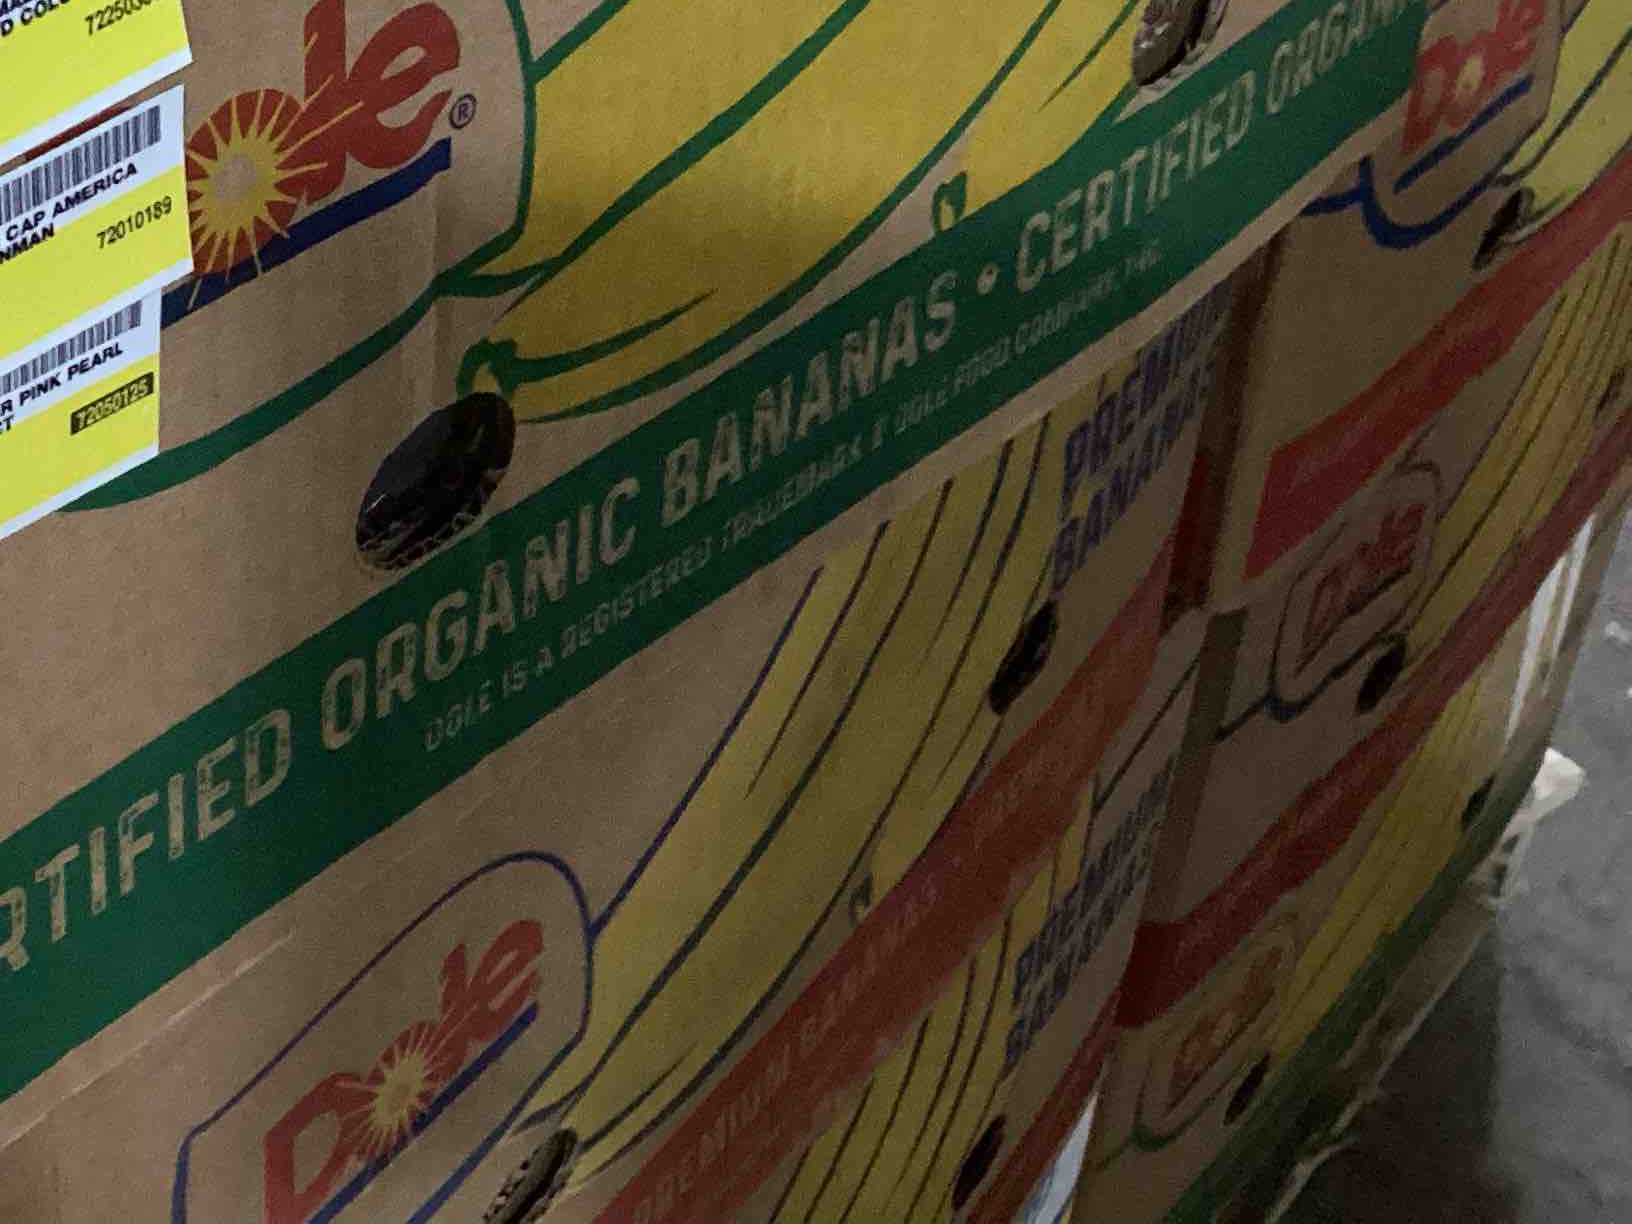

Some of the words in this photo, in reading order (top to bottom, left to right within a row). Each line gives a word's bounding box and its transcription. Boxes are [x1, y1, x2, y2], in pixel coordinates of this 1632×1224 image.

[5, 209, 47, 246] CAP
[52, 162, 139, 222] AMERICA
[95, 195, 174, 251] 72010189
[18, 372, 62, 411] PINK
[66, 342, 125, 387] PEARL
[319, 476, 642, 752] ORGANIC
[660, 271, 959, 528] BANANAS
[1015, 70, 1258, 292] CERTIFIED
[262, 918, 546, 1223] Dole
